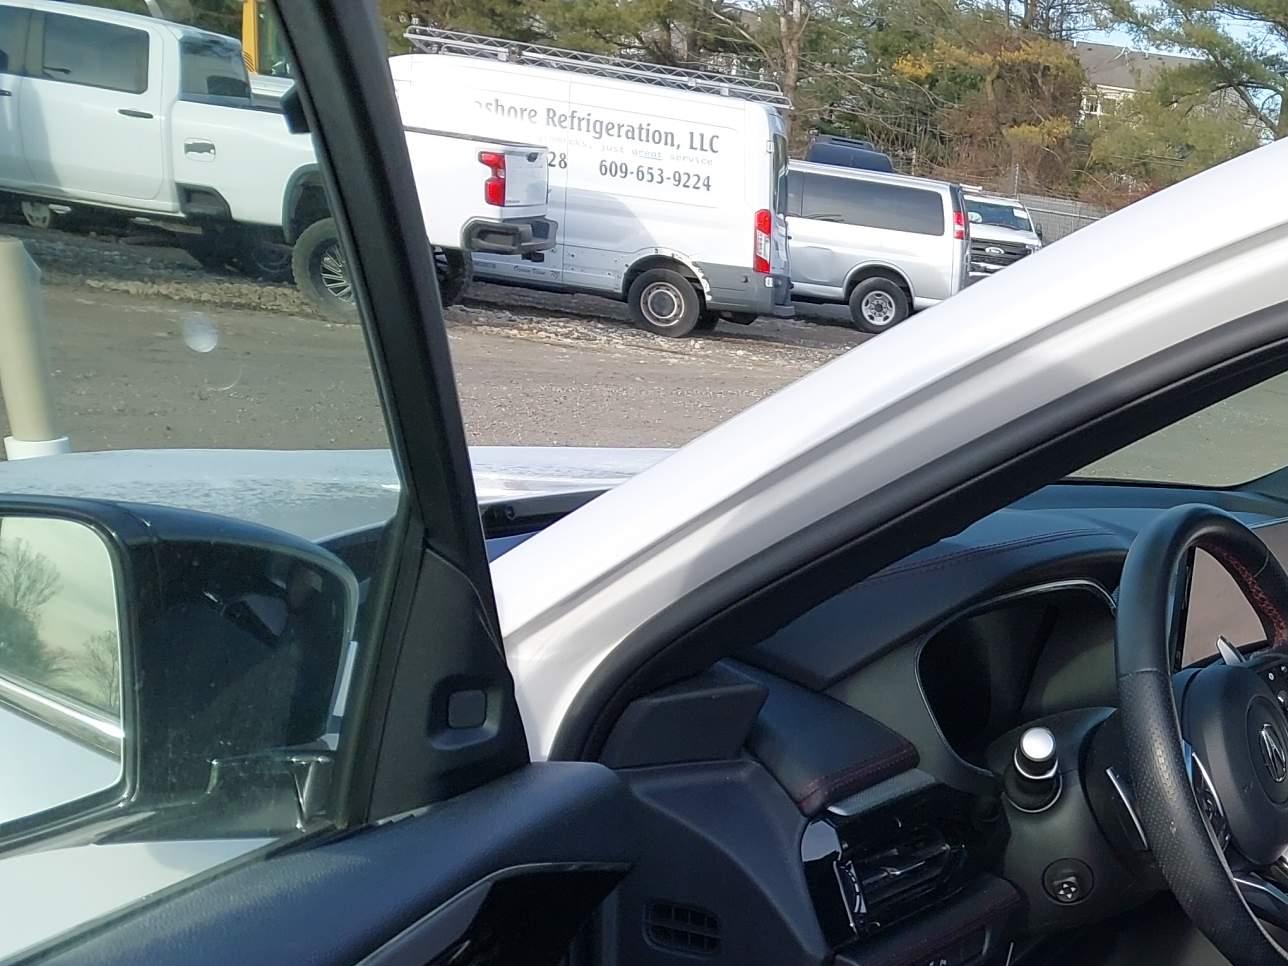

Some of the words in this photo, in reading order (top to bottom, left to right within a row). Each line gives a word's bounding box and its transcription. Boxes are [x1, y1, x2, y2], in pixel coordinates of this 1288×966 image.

[545, 107, 681, 151] Refrigeration,
[689, 131, 720, 154] LLC
[598, 158, 712, 192] 609-653-9224
